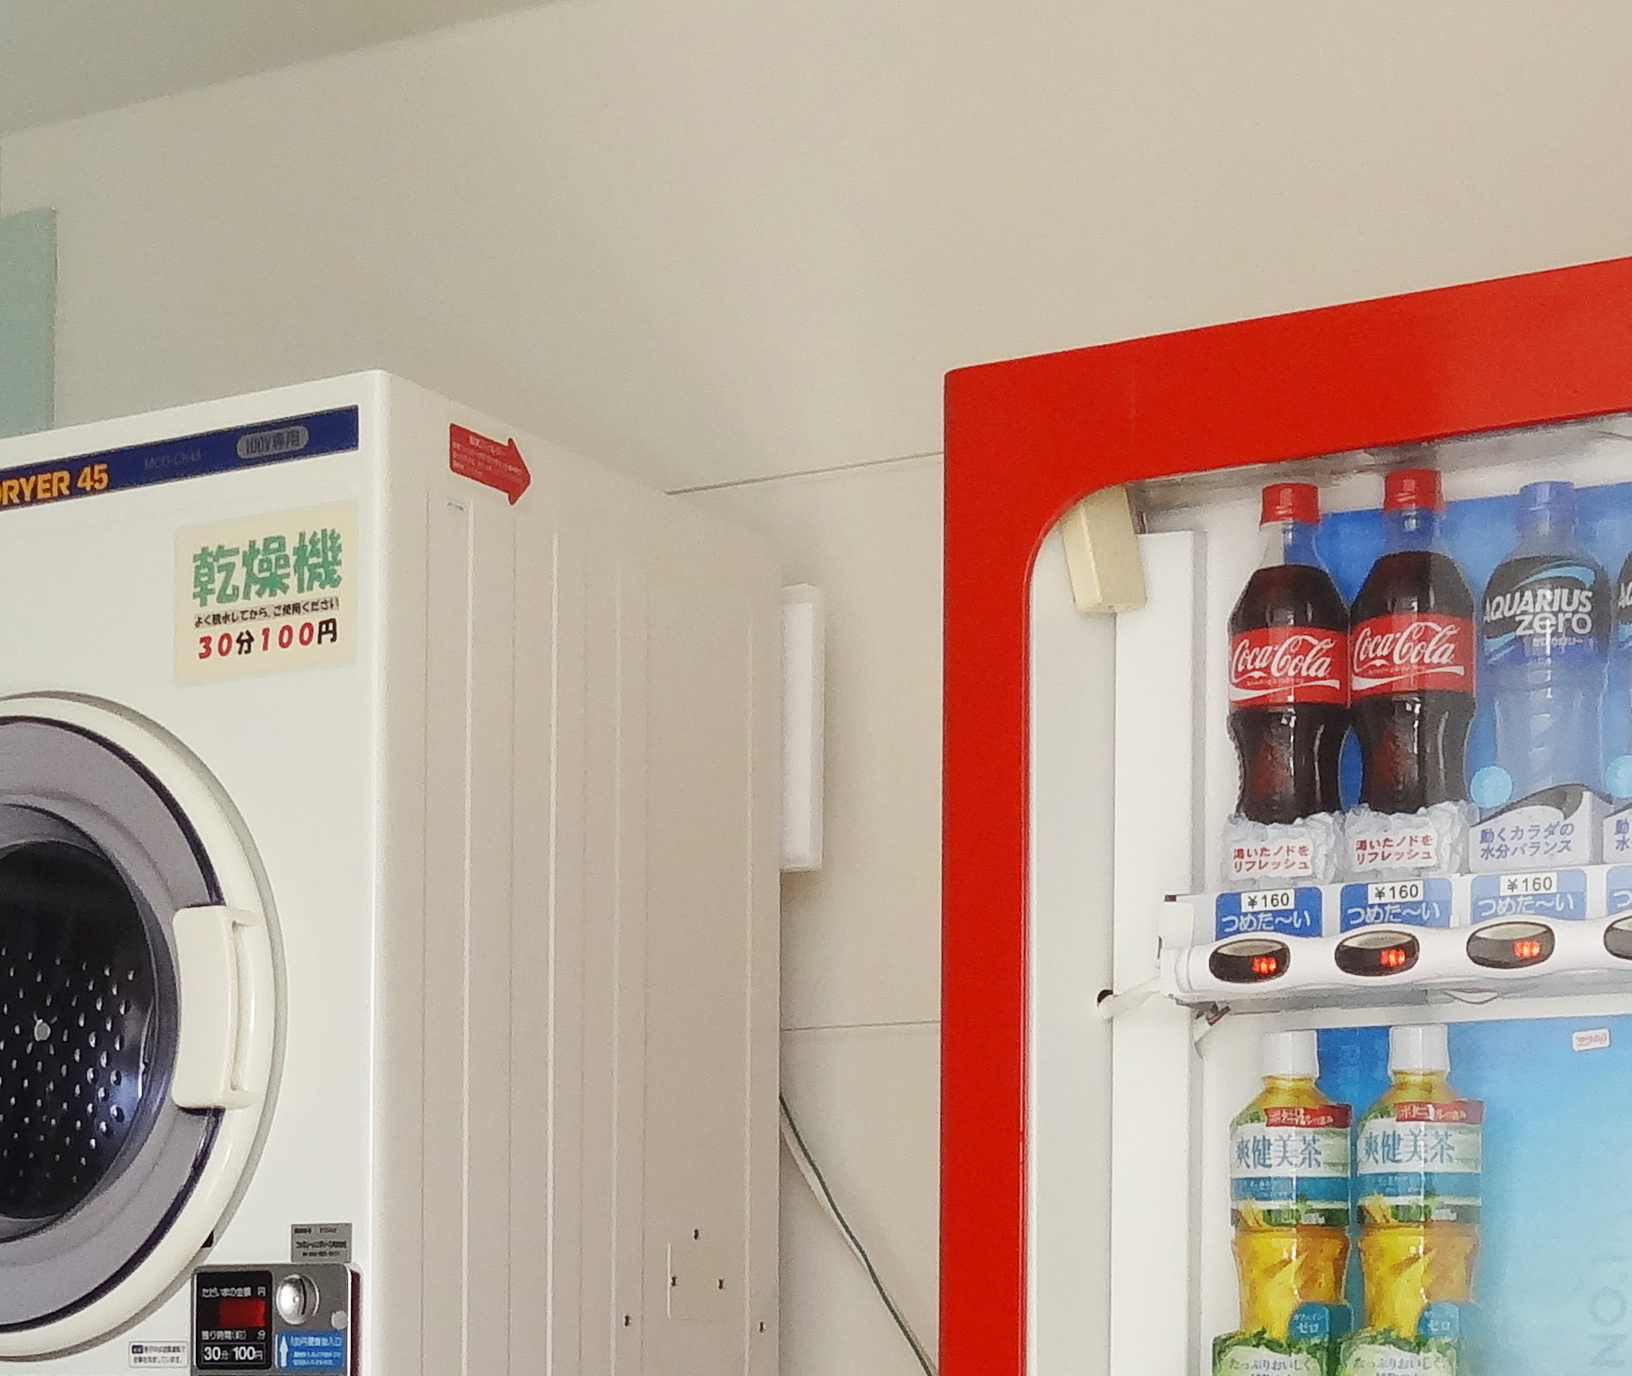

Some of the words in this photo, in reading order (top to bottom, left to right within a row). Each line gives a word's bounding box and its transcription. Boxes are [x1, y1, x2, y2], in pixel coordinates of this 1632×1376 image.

[76, 463, 108, 492] 45
[193, 529, 342, 607] 乾燥機
[1483, 587, 1593, 624] AQUARIUS
[1515, 609, 1592, 637] zero
[199, 618, 337, 659] 30分100円
[1352, 621, 1459, 666] Coca-Cola
[1231, 634, 1335, 678] Coca-Cola
[1479, 820, 1576, 845] 動くカラダの
[1356, 847, 1433, 866] リフレッシュ
[1479, 834, 1573, 859] 水分バランス
[1234, 859, 1310, 873] リフレッシュ
[1374, 883, 1419, 900] ¥160
[1506, 876, 1554, 892] ¥160
[1247, 892, 1290, 908] ¥160
[1235, 1134, 1323, 1169] 爽健美茶
[1362, 1130, 1457, 1165] 爽健美茶
[1296, 1321, 1319, 1335] ゼロ
[1426, 1319, 1451, 1333] ゼロ
